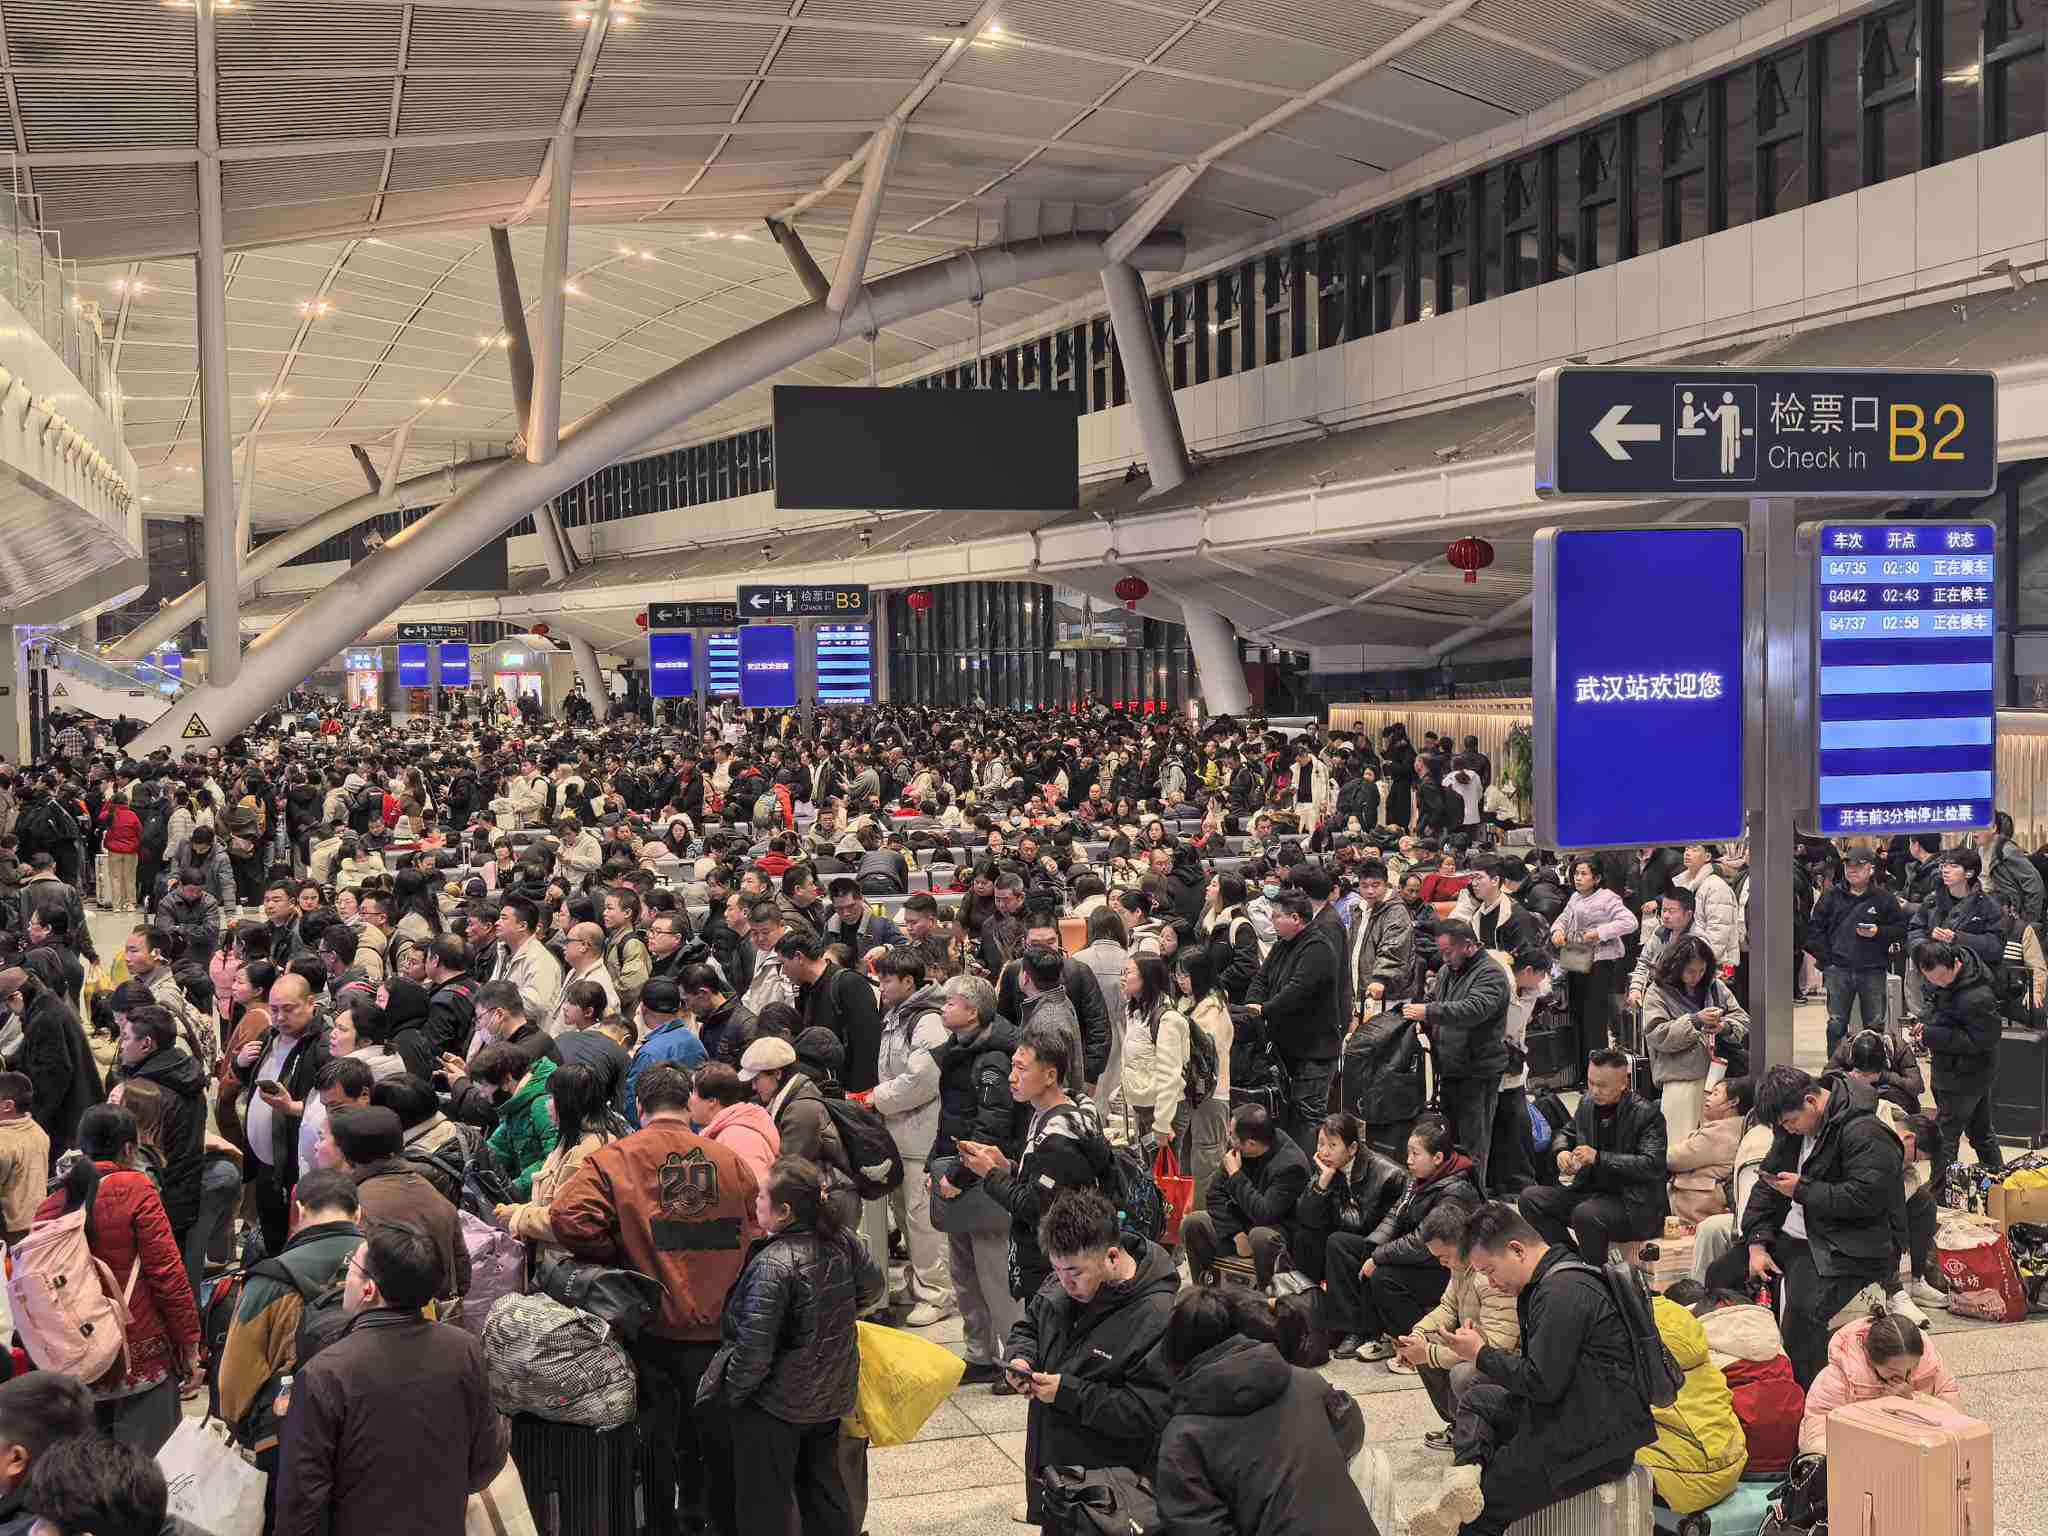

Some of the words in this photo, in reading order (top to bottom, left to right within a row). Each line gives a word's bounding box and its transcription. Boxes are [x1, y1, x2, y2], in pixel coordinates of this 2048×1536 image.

[1770, 392, 1879, 435] 检票口
[1888, 403, 1966, 463] B2
[1768, 446, 1841, 470] Check
[1848, 446, 1867, 470] in
[1833, 531, 1863, 549] 车次
[1887, 531, 1917, 549] 开点
[1947, 531, 1976, 549] 状态
[1829, 561, 1867, 575] G4735
[1883, 560, 1921, 575] 02:30
[1933, 559, 1988, 576] 正在候车
[836, 592, 861, 609] B3
[1829, 589, 1867, 603] G4842
[1883, 588, 1920, 602] 02:43
[1933, 586, 1988, 603] 正在候车
[1829, 617, 1867, 631] G4737
[1933, 614, 1988, 631] 正在候车
[1575, 671, 1722, 703] 武汉站欢迎您
[1839, 804, 1974, 827] 开车前3分钟停止检票
